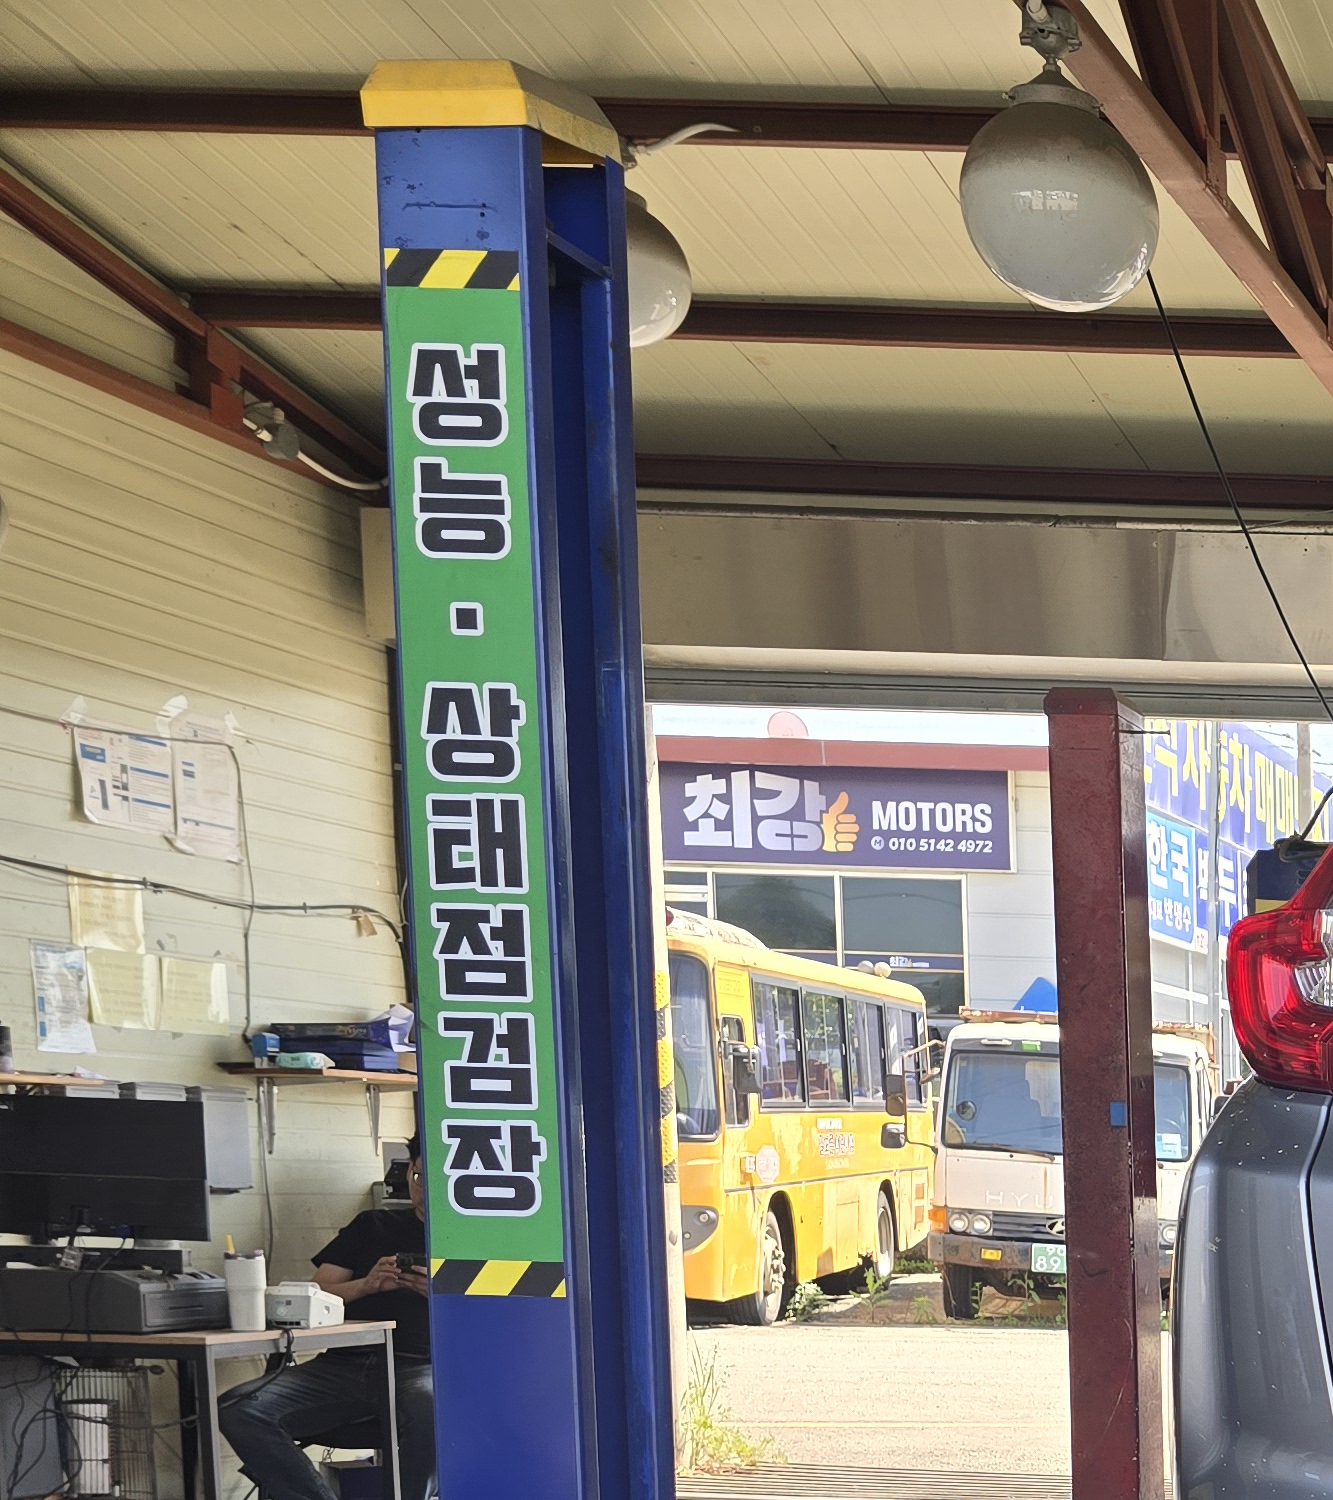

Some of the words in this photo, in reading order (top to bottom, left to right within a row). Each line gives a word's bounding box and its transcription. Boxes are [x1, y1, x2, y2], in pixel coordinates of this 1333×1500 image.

[683, 771, 827, 852] 최강
[872, 800, 993, 833] MOTORS
[889, 838, 916, 851] 010
[919, 838, 954, 852] 5142
[957, 839, 993, 853] 4972
[1148, 821, 1190, 898] 한국
[1036, 1255, 1062, 1273] 89
